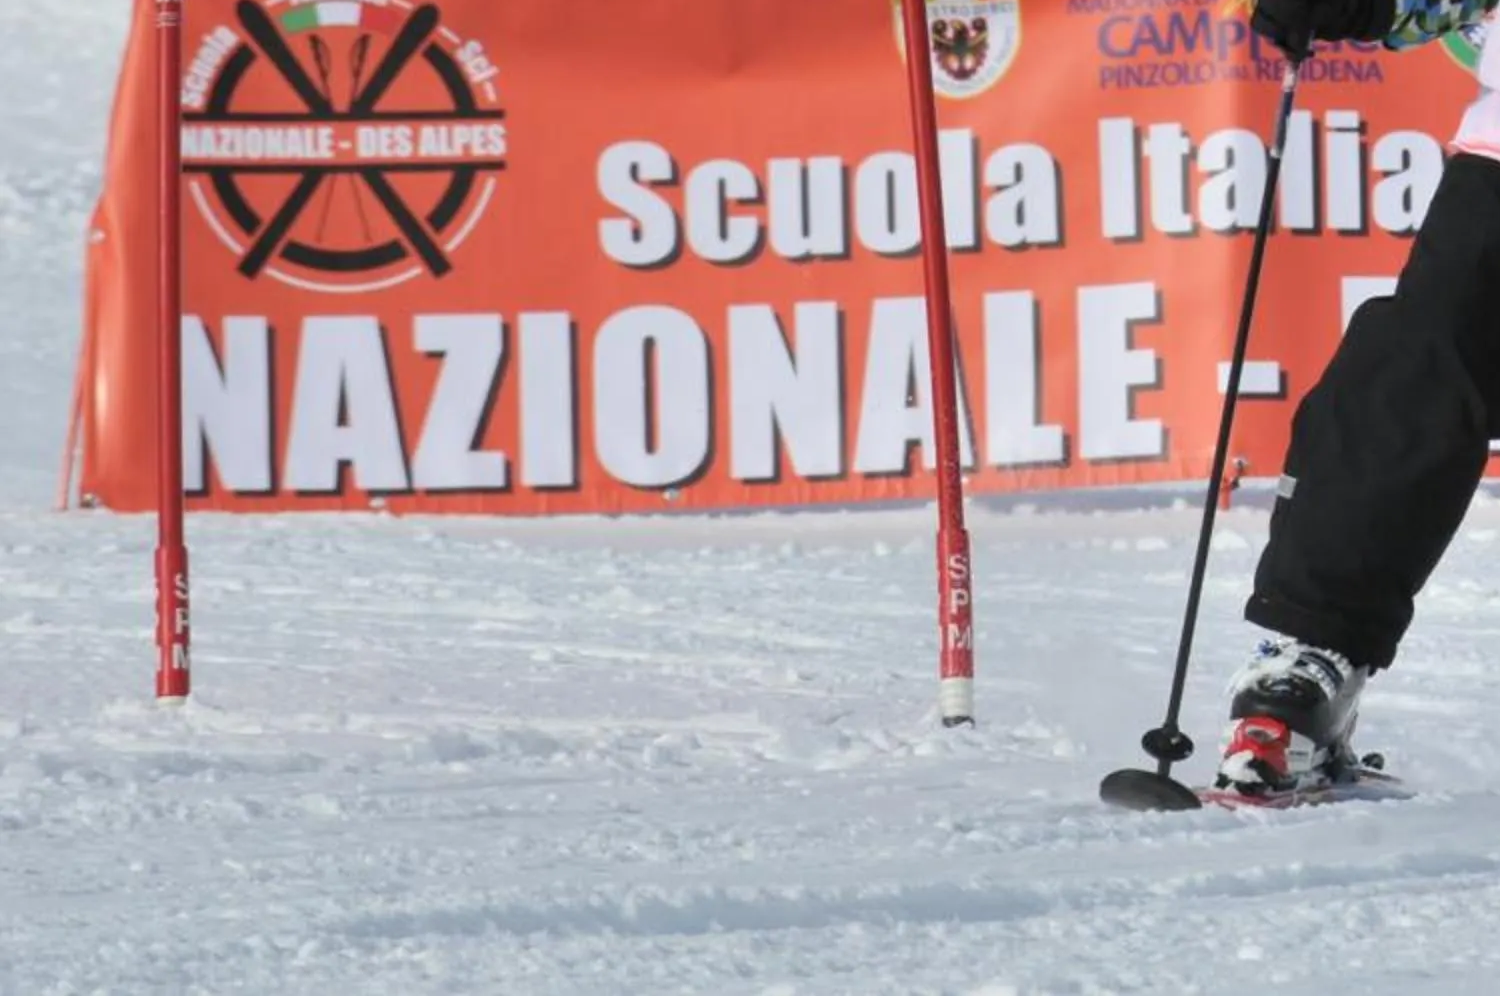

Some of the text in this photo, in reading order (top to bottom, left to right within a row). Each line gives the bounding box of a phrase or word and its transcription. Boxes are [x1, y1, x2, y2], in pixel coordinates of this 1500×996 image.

[1100, 58, 1217, 90] PINZOLO
[1255, 56, 1383, 83] REDENA
[181, 127, 334, 159] NAZIONALE
[356, 125, 413, 158] DES
[418, 124, 507, 158] ALPES
[597, 128, 1060, 266] Scuola
[181, 283, 1164, 494] NAZIONALE
